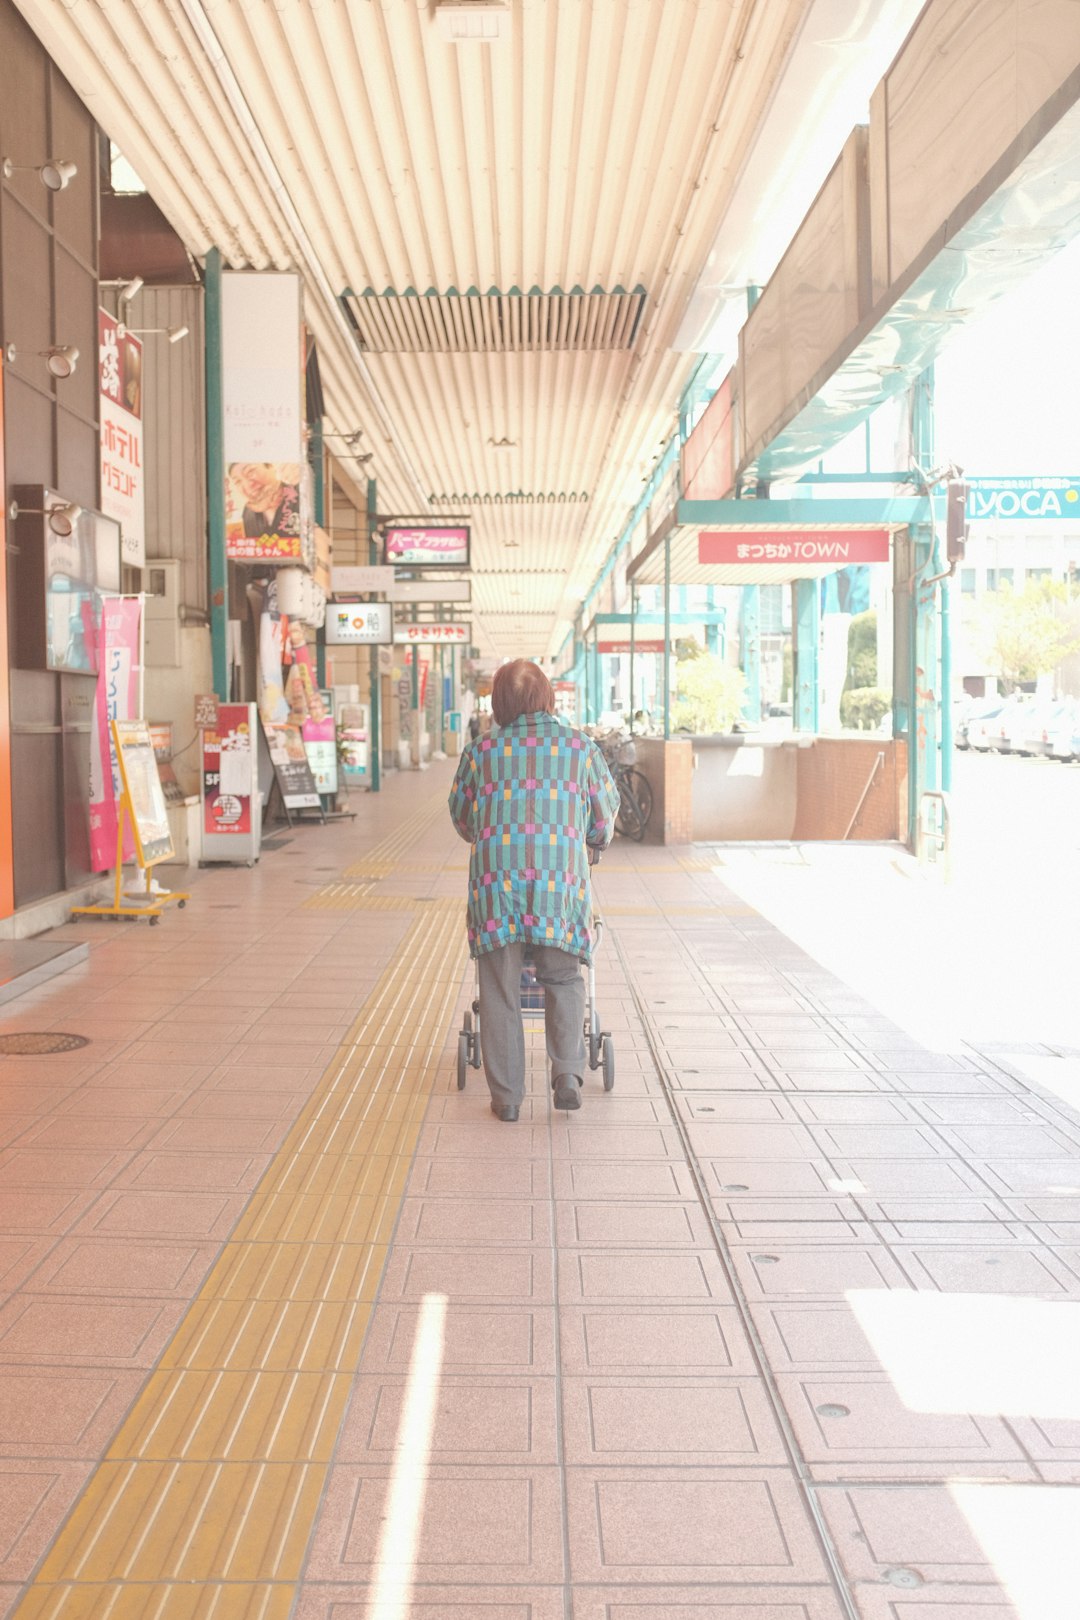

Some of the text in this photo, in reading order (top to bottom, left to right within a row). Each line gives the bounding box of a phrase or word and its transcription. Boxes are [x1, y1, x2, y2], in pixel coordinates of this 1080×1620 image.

[103, 420, 140, 468] ホテル
[969, 490, 1062, 517] IYOCA
